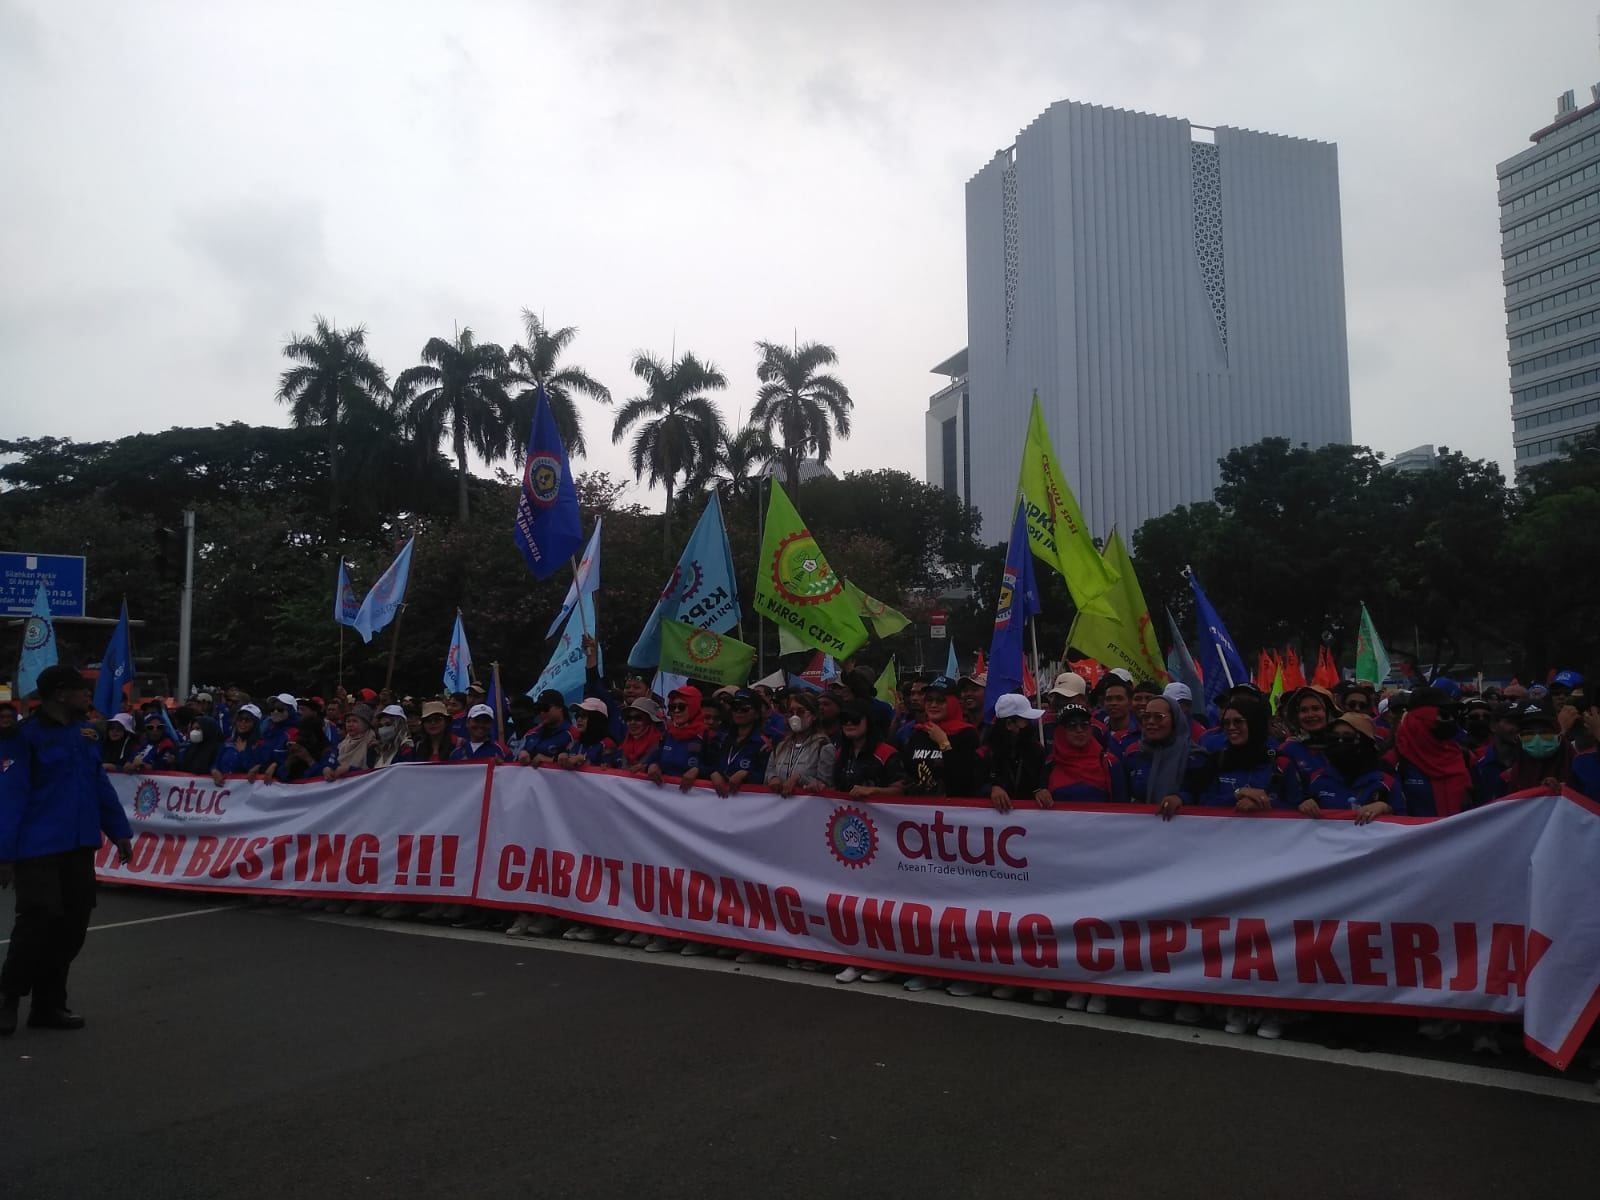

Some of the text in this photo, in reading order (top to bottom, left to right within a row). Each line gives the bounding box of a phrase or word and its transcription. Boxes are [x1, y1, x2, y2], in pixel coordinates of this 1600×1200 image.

[808, 625, 846, 652] CIPTA
[930, 750, 943, 759] DA
[167, 781, 230, 815] atuc
[896, 811, 1028, 868] atuc
[183, 833, 380, 884] BUSTING
[898, 861, 1029, 881] Asean Trade Union Council
[498, 845, 623, 906] CABUT
[1073, 917, 1279, 982] CIPTA
[1293, 919, 1530, 997] KERJA
